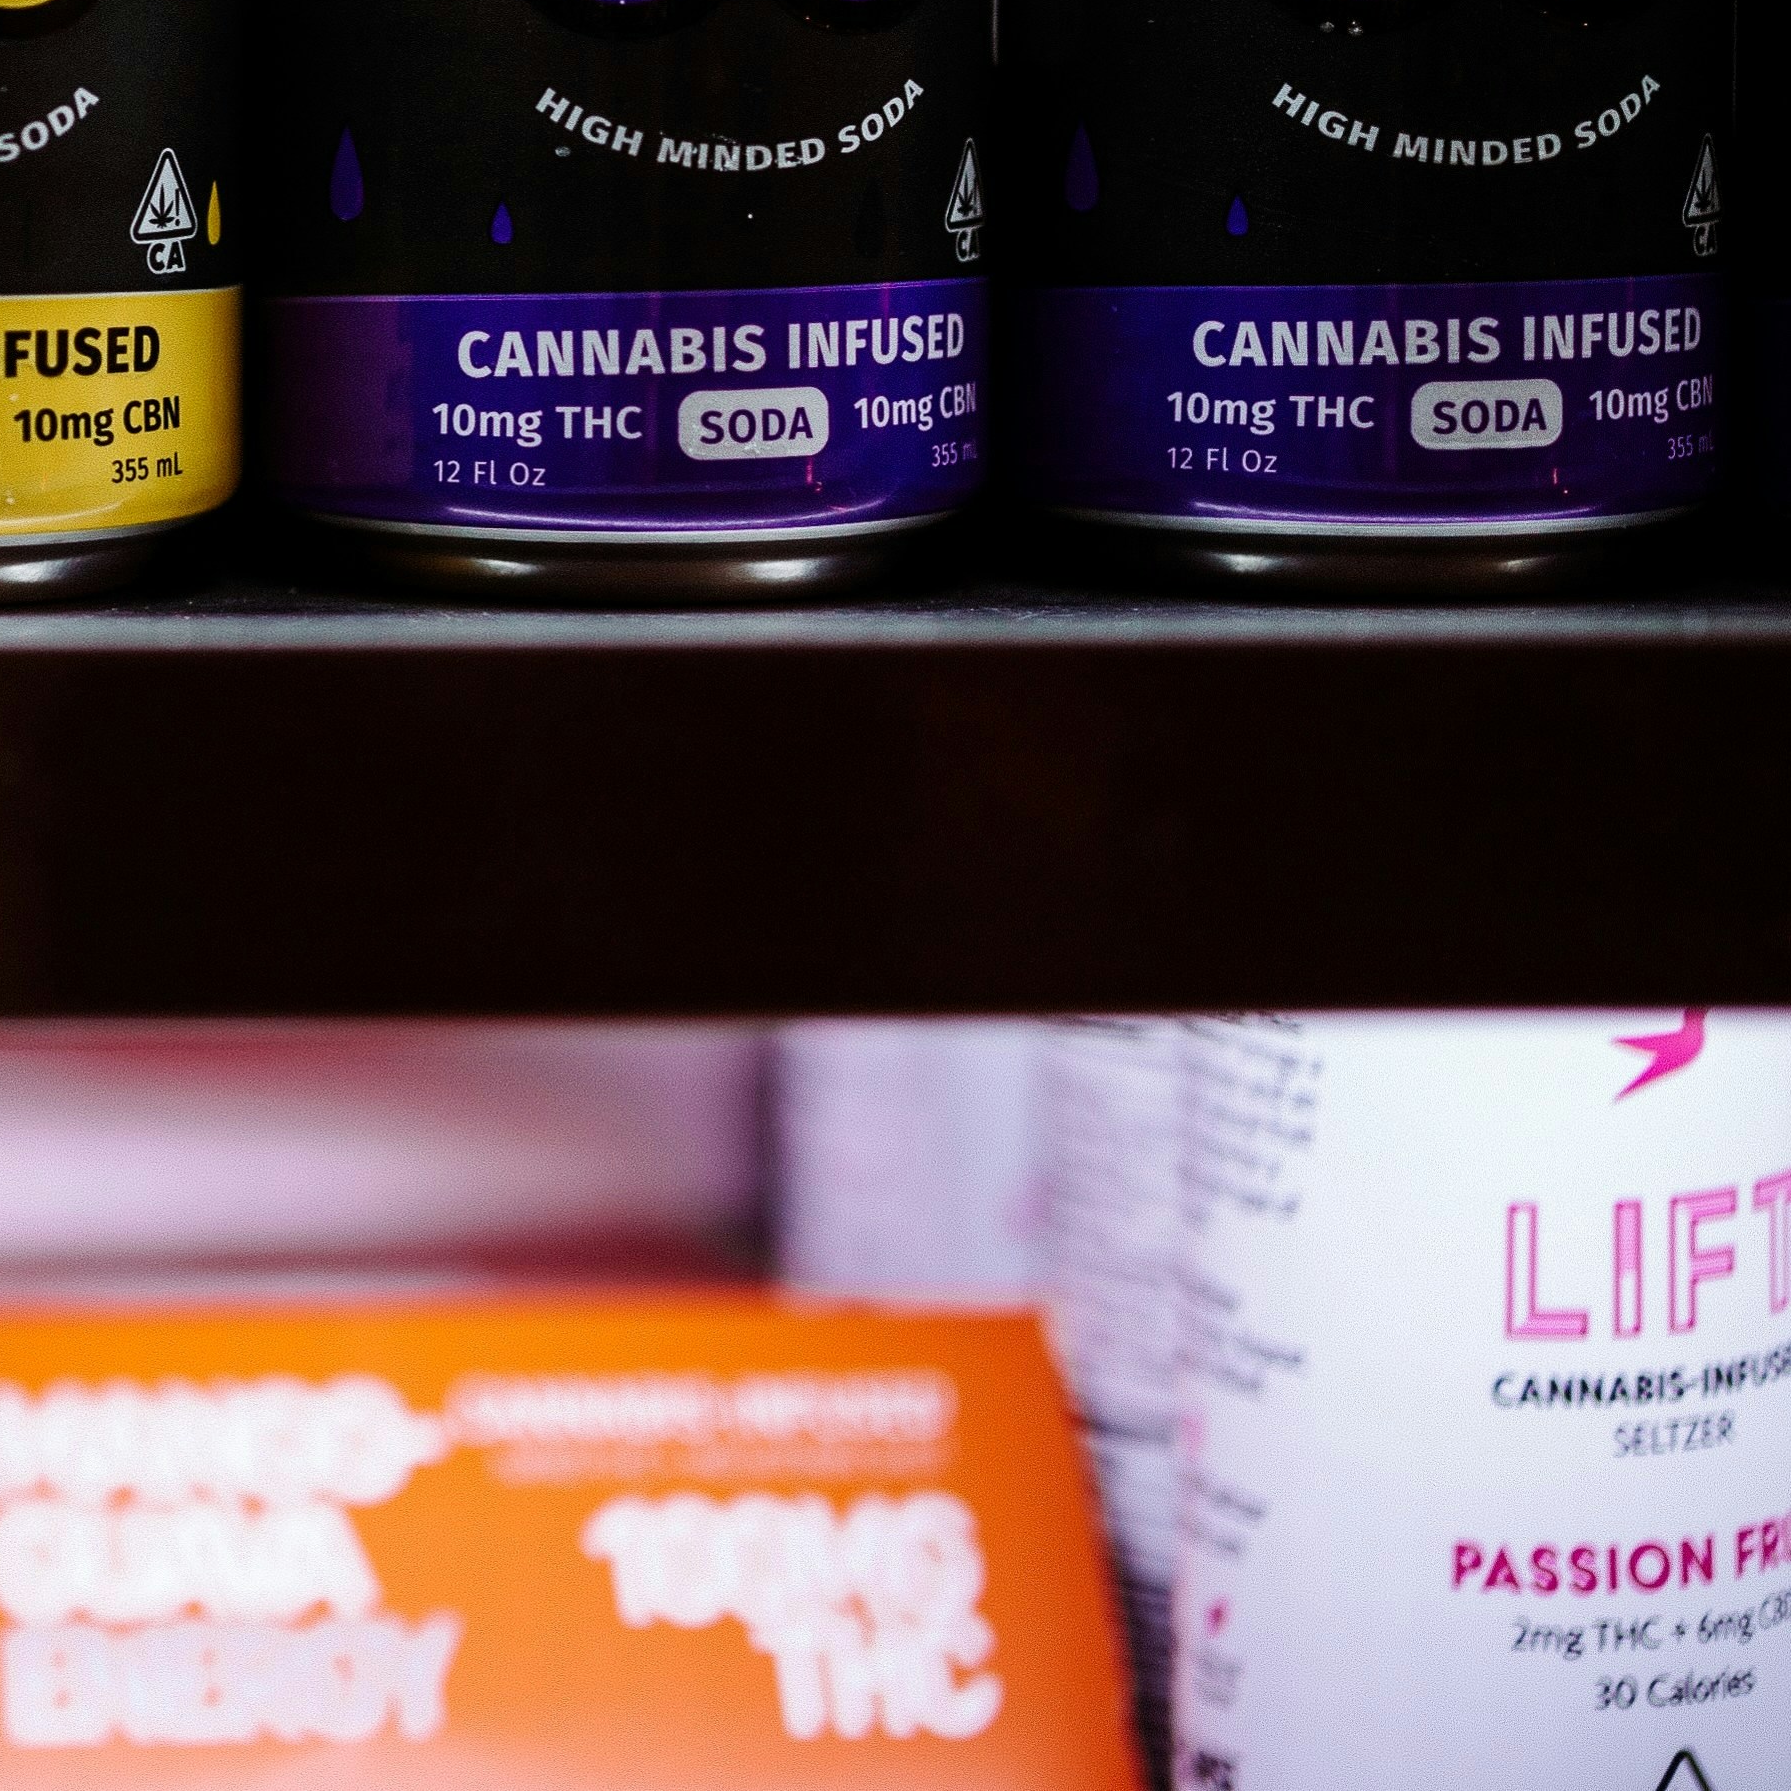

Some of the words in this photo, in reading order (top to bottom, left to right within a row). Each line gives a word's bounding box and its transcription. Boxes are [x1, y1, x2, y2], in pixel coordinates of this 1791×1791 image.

[534, 87, 645, 157] HIGH
[656, 135, 827, 172] MINDED
[837, 78, 925, 154] SODA
[1271, 82, 1381, 152] HIGH
[1392, 132, 1563, 167] MINDED
[1574, 74, 1662, 150] SODA
[457, 325, 766, 379] CANNABIS
[788, 313, 965, 370] INFUSED
[1192, 316, 1500, 367] CANNABIS
[1523, 307, 1702, 363] INFUSED
[14, 408, 115, 445] 10mg
[123, 395, 181, 436] CBN
[432, 403, 543, 448] 10mg
[555, 405, 643, 440] THC
[699, 408, 814, 444] SODA
[853, 393, 933, 432] 10mg
[939, 381, 976, 419] CBN
[1167, 392, 1277, 435] 10mg
[1288, 395, 1375, 428] THC
[1432, 398, 1547, 434] SODA
[1589, 387, 1669, 424] 10mg
[111, 458, 149, 485] 355
[156, 453, 183, 478] mL
[932, 442, 957, 468] 355
[1167, 447, 1193, 470] 12
[1207, 447, 1228, 472] Fl
[1241, 449, 1278, 473] Oz
[1667, 433, 1694, 460] 355
[433, 460, 460, 483] 12
[474, 460, 497, 485] Fl
[509, 460, 545, 486] Oz
[1502, 1169, 1791, 1340] LIFT
[1614, 1408, 1736, 1459] SELTZER
[1451, 1530, 1716, 1598] PASSION
[1510, 1614, 1585, 1661] 2mg
[1592, 1613, 1664, 1650] THC
[1695, 1607, 1755, 1645] 6mg
[754, 1609, 1005, 1743] THC
[1595, 1672, 1639, 1710] 30
[1646, 1666, 1758, 1708] Calories
